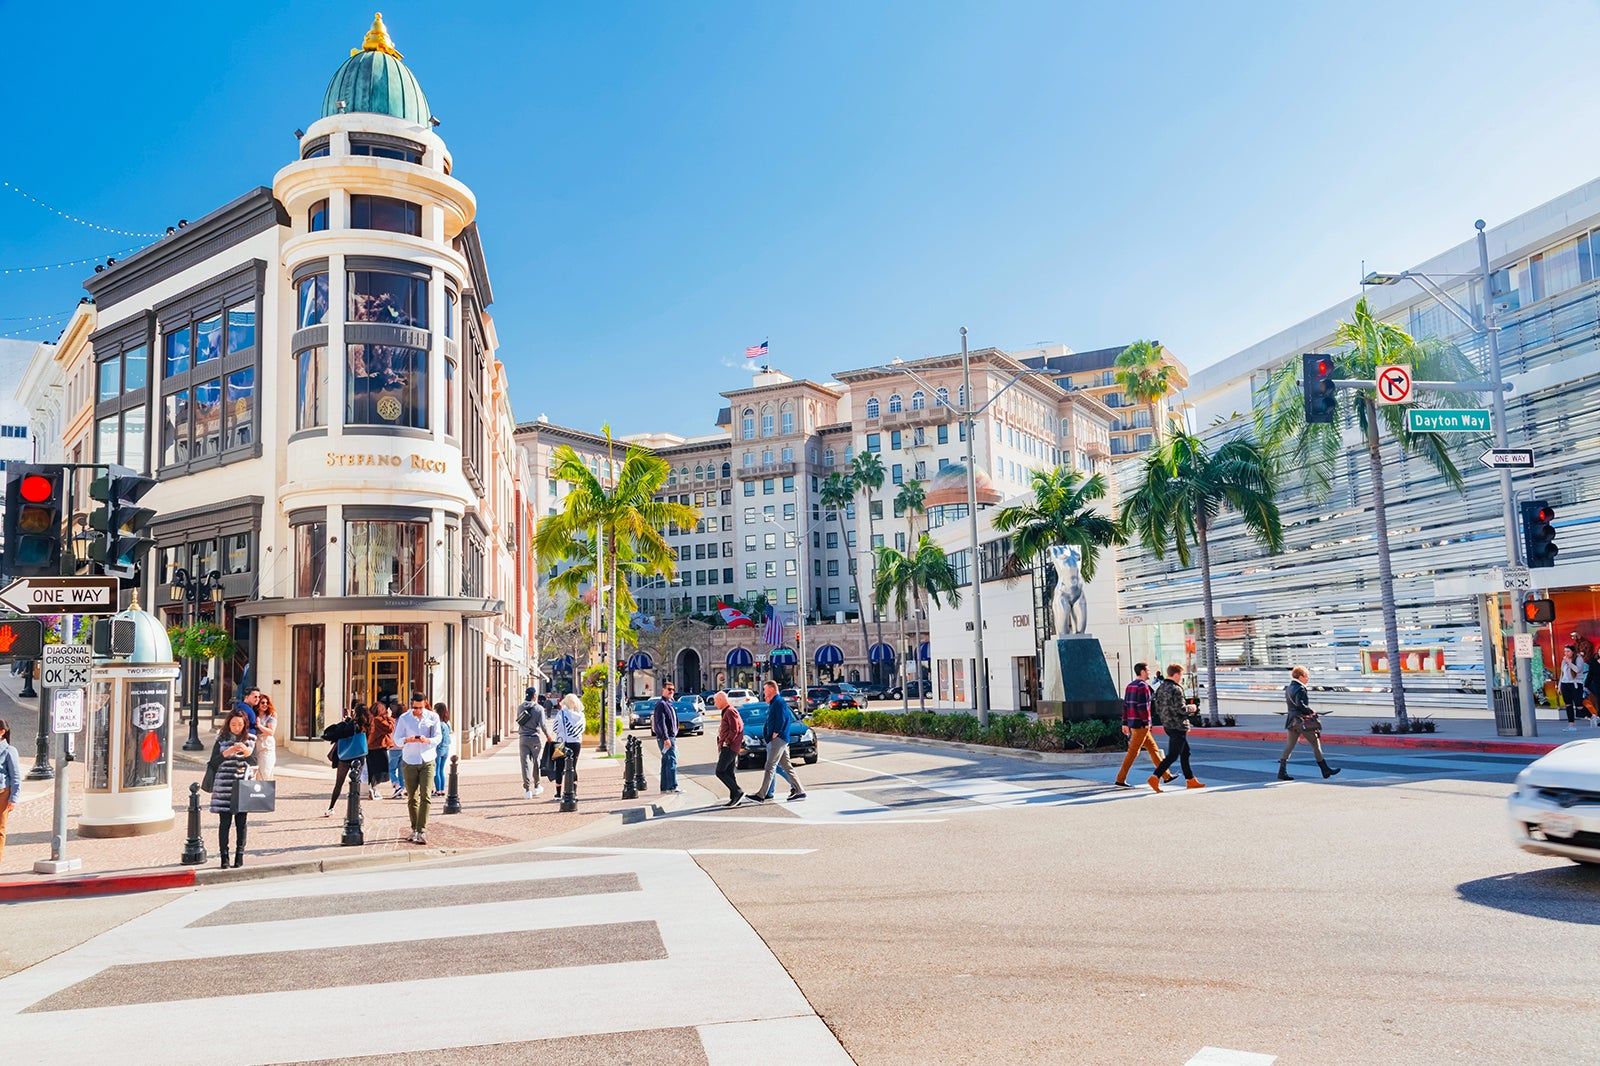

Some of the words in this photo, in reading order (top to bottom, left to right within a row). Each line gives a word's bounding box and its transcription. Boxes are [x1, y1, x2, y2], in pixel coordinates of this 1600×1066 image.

[1415, 414, 1458, 429] Dayton
[1461, 414, 1485, 429] Way
[326, 452, 402, 467] STEFANO
[1494, 454, 1509, 463] ONE
[1512, 454, 1527, 463] WAY
[1505, 580, 1515, 588] OK
[33, 589, 64, 603] ONE
[71, 589, 103, 603] WAY
[1012, 615, 1030, 627] FENDI
[46, 646, 89, 655] DIAGONAL
[45, 656, 90, 665] CROSSING
[45, 669, 62, 683] OK
